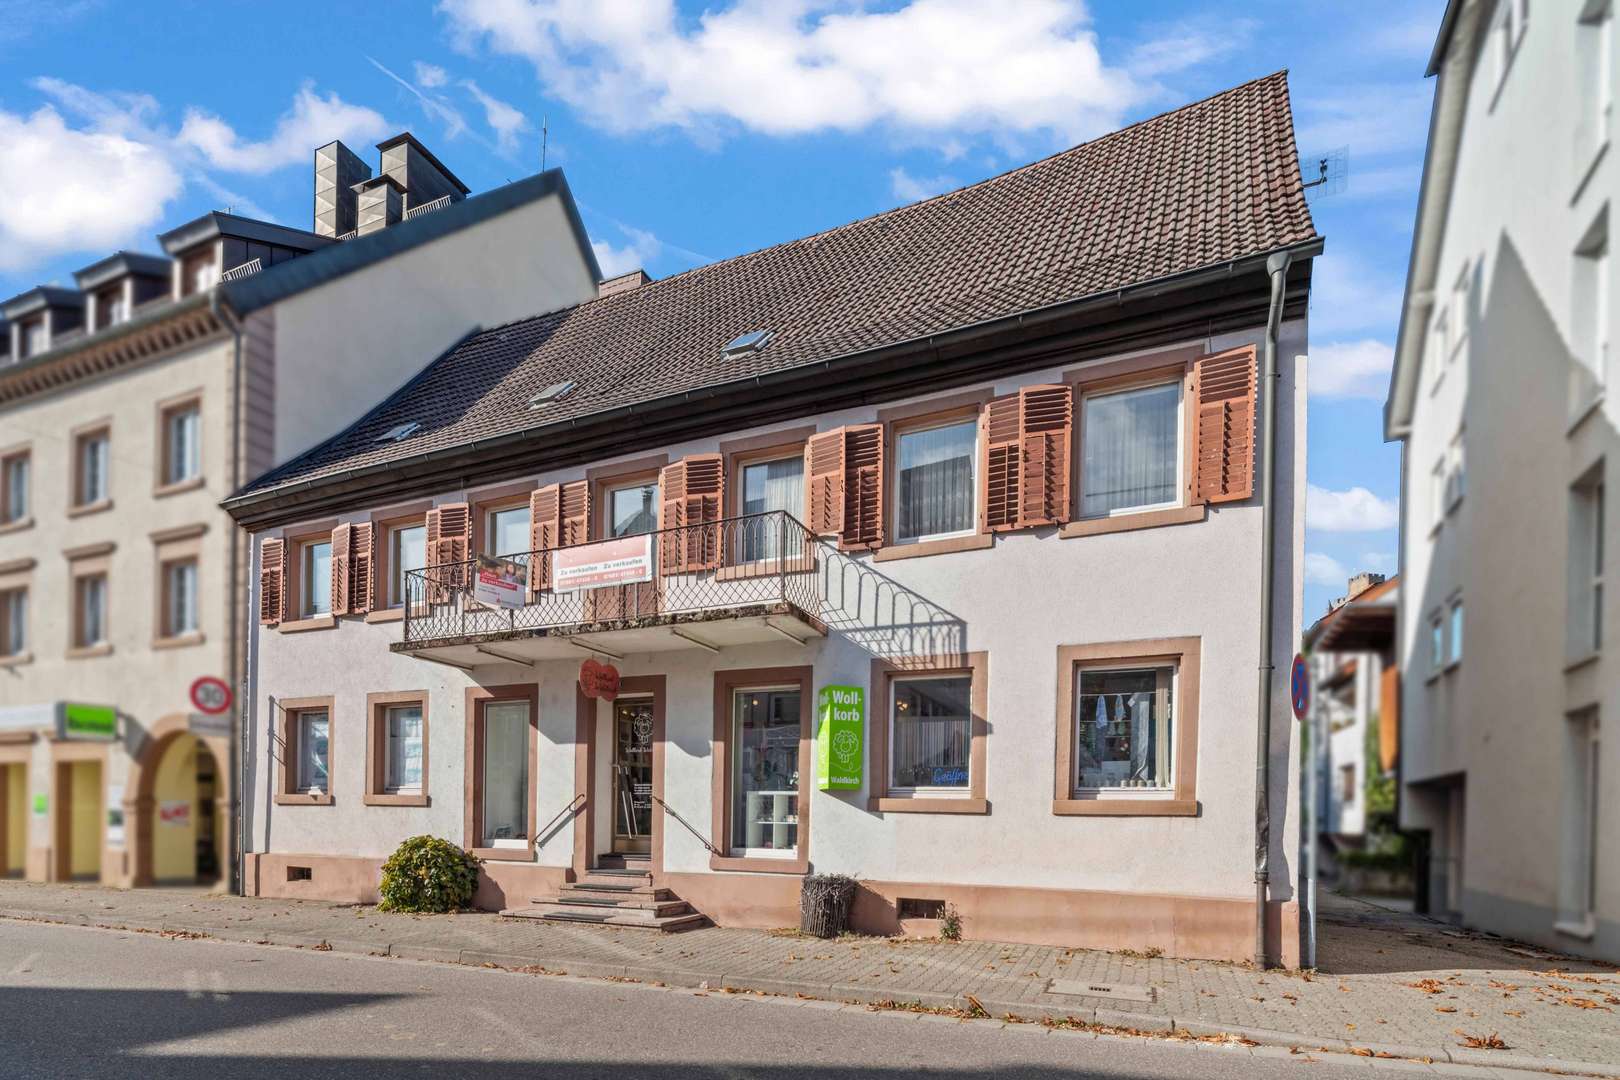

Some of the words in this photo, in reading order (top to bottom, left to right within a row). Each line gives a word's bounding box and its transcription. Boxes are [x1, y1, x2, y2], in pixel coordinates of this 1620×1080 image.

[832, 690, 862, 704] Woll-
[834, 707, 860, 721] korb
[830, 775, 860, 785] Waldkirch
